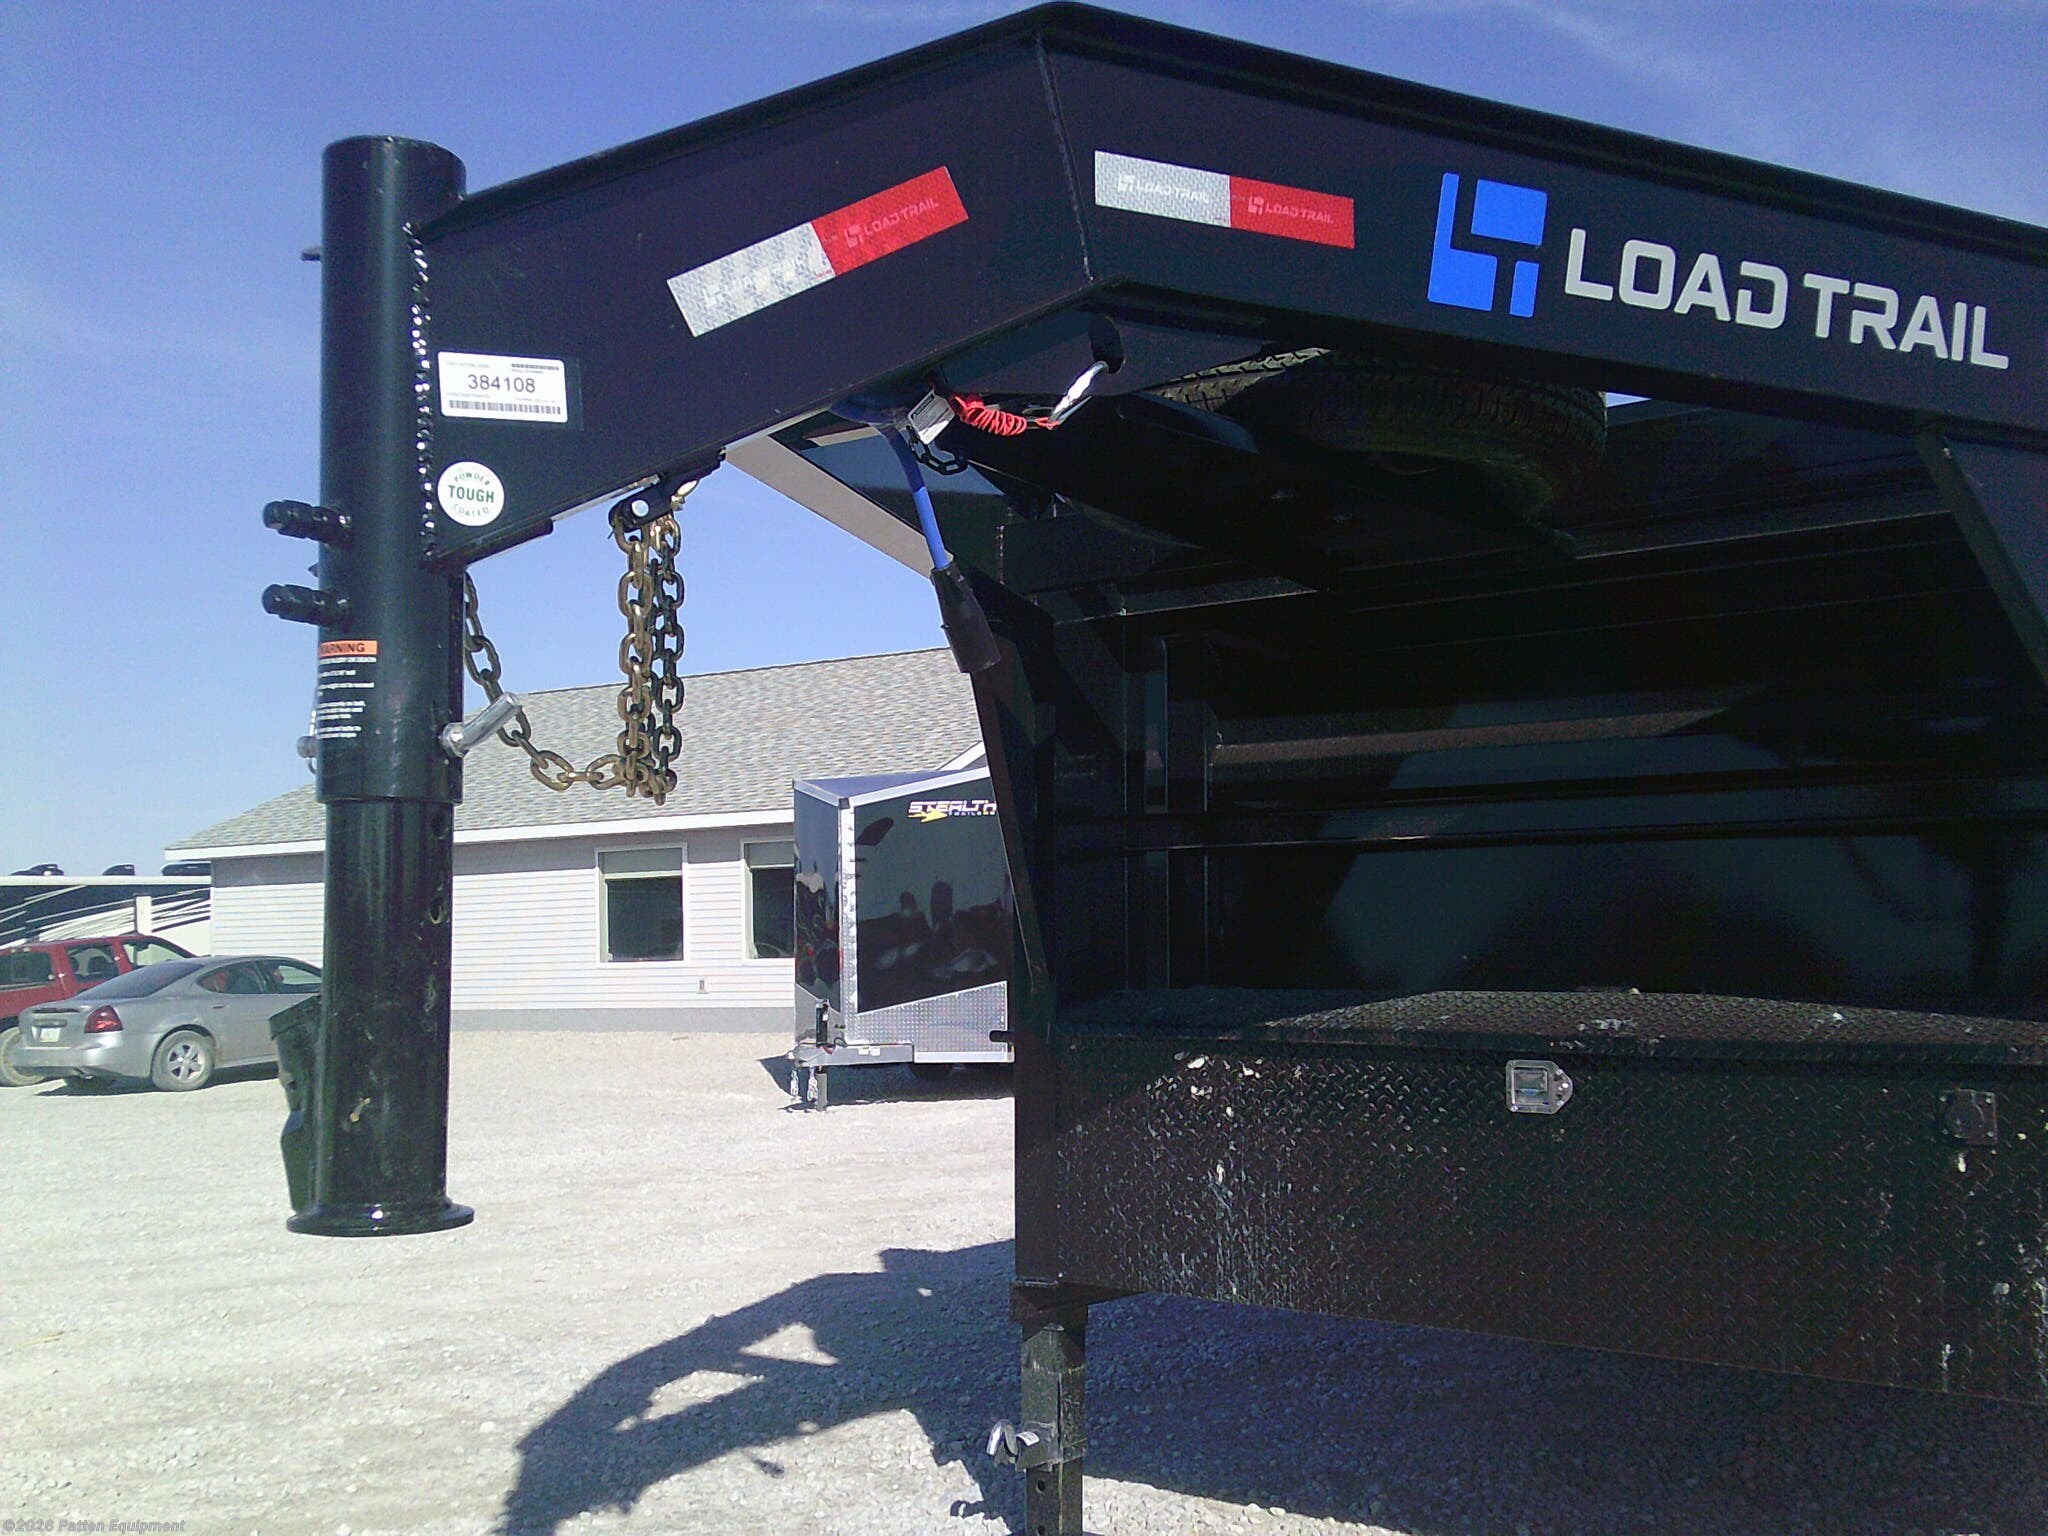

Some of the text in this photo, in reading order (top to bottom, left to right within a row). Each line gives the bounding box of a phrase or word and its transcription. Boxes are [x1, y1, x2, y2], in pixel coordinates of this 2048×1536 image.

[863, 198, 940, 236] LOAD TRAIL
[1264, 202, 1334, 224] LOAD TRAIL
[1564, 227, 2010, 370] LOAD TRAIL
[467, 373, 536, 394] 384108
[448, 484, 495, 504] TOUGH
[908, 799, 997, 814] STEALTH
